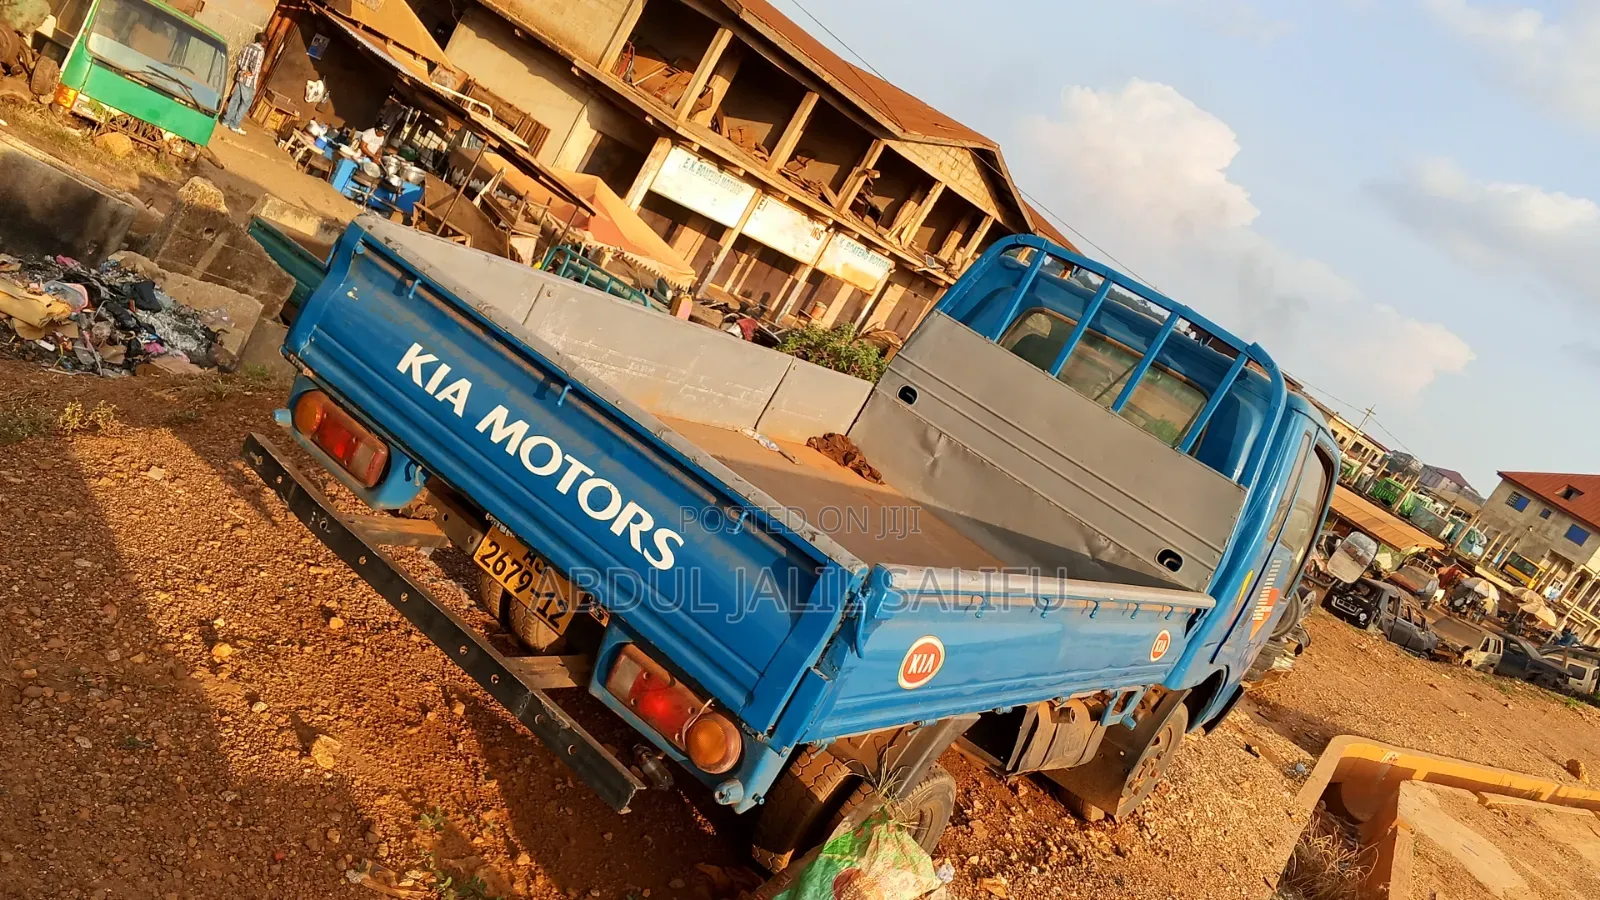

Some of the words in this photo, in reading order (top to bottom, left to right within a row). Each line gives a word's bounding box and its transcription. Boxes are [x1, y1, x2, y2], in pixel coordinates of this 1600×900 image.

[396, 342, 473, 418] KIA
[475, 404, 685, 572] MOTORS
[479, 540, 570, 630] 2679-12
[906, 652, 936, 675] KIA
